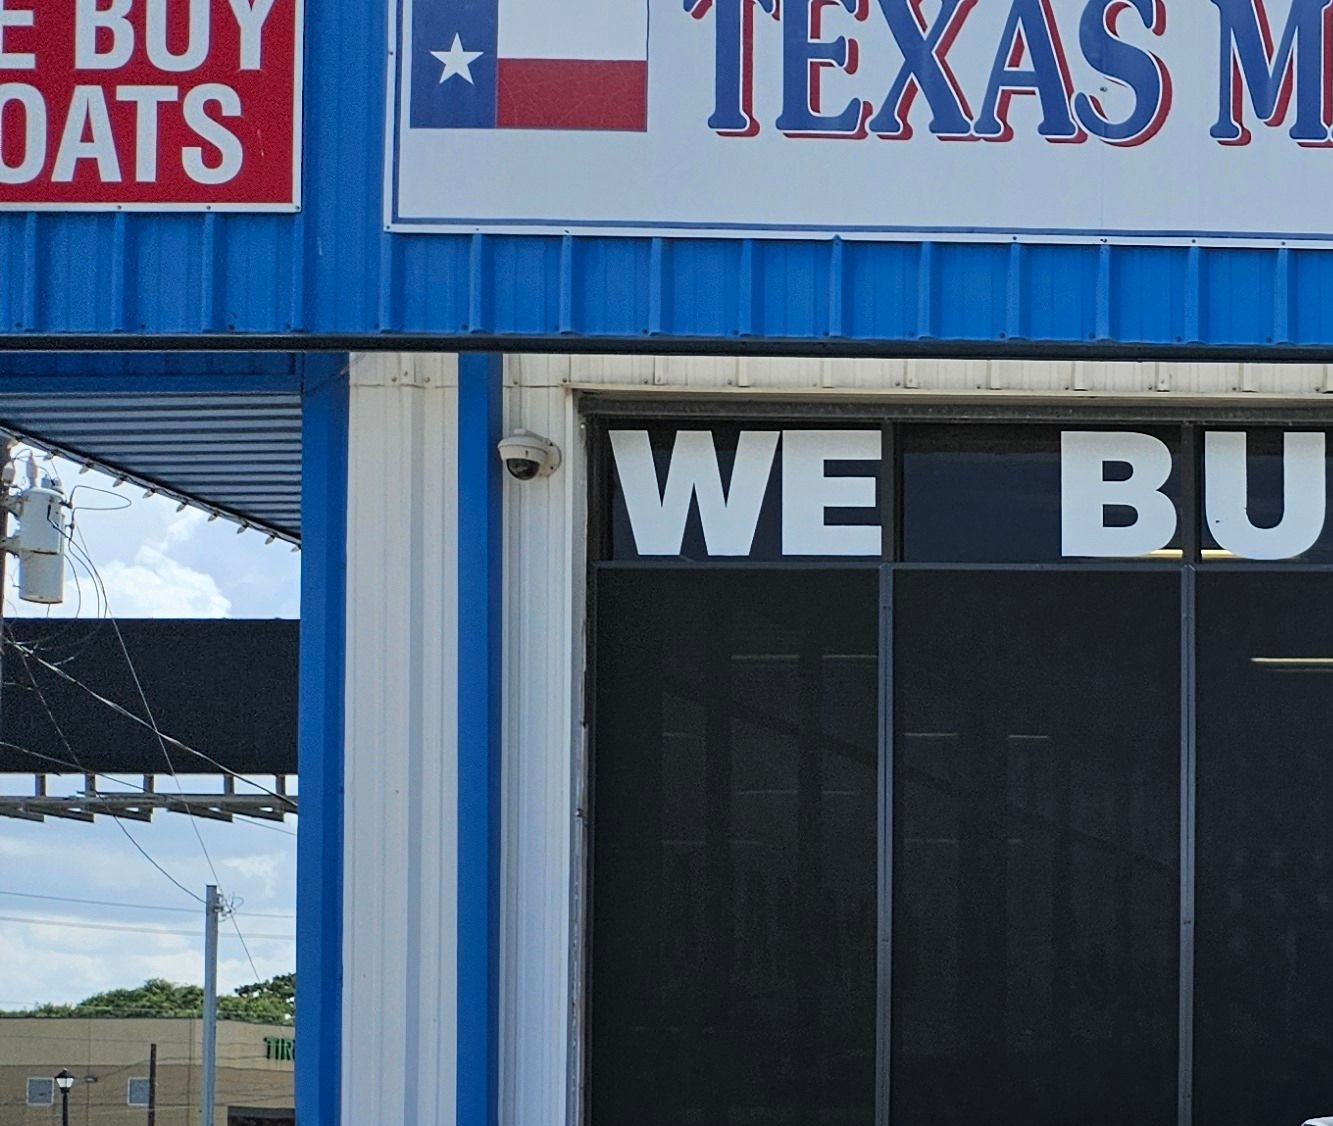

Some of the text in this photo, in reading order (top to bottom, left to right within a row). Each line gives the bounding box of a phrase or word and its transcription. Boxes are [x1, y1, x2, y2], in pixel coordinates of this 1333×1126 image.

[74, 0, 276, 72] BUY
[683, 0, 1173, 148] TEXAS
[0, 82, 244, 185] OATS
[608, 430, 883, 556] WE
[263, 1036, 295, 1061] TIR
